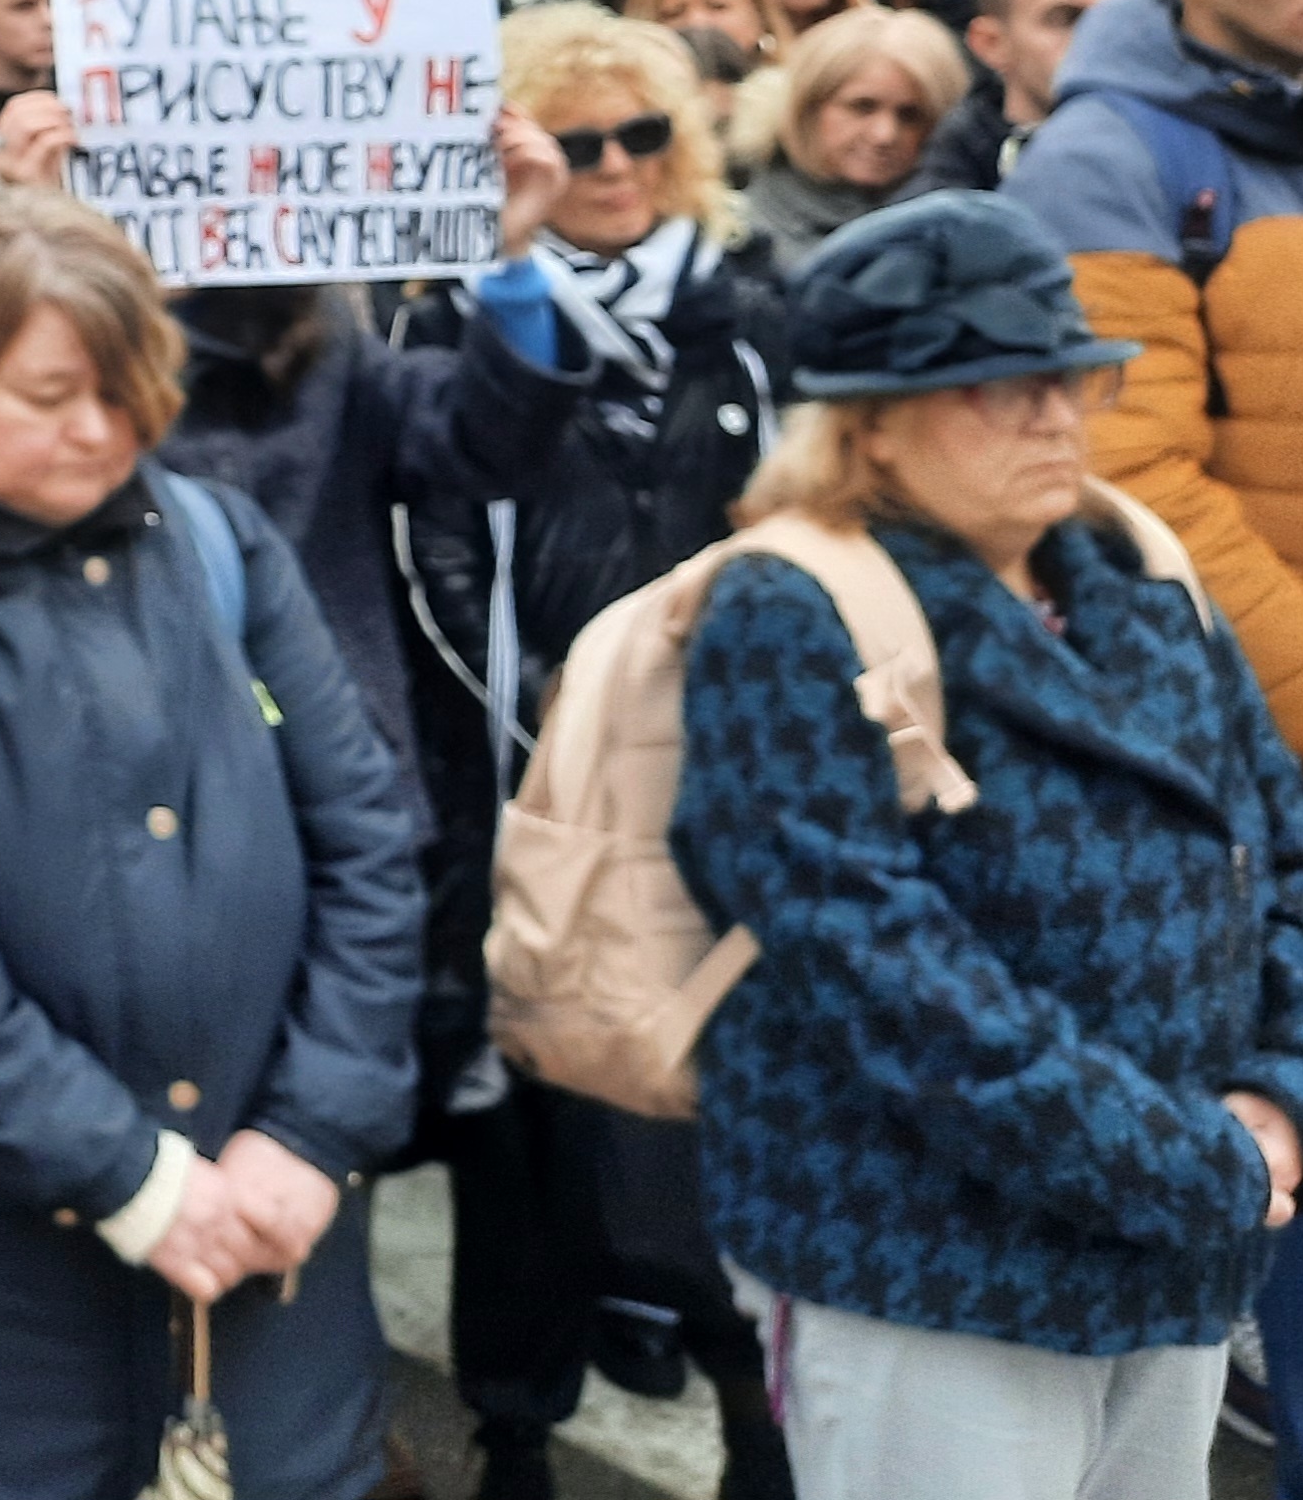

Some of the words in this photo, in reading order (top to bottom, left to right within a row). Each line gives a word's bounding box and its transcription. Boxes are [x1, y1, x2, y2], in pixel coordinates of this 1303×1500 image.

[81, 54, 405, 127] ПРИСУСТВУ
[69, 143, 226, 197] ПРАВДЕ
[199, 205, 263, 270] ВЕЋ
